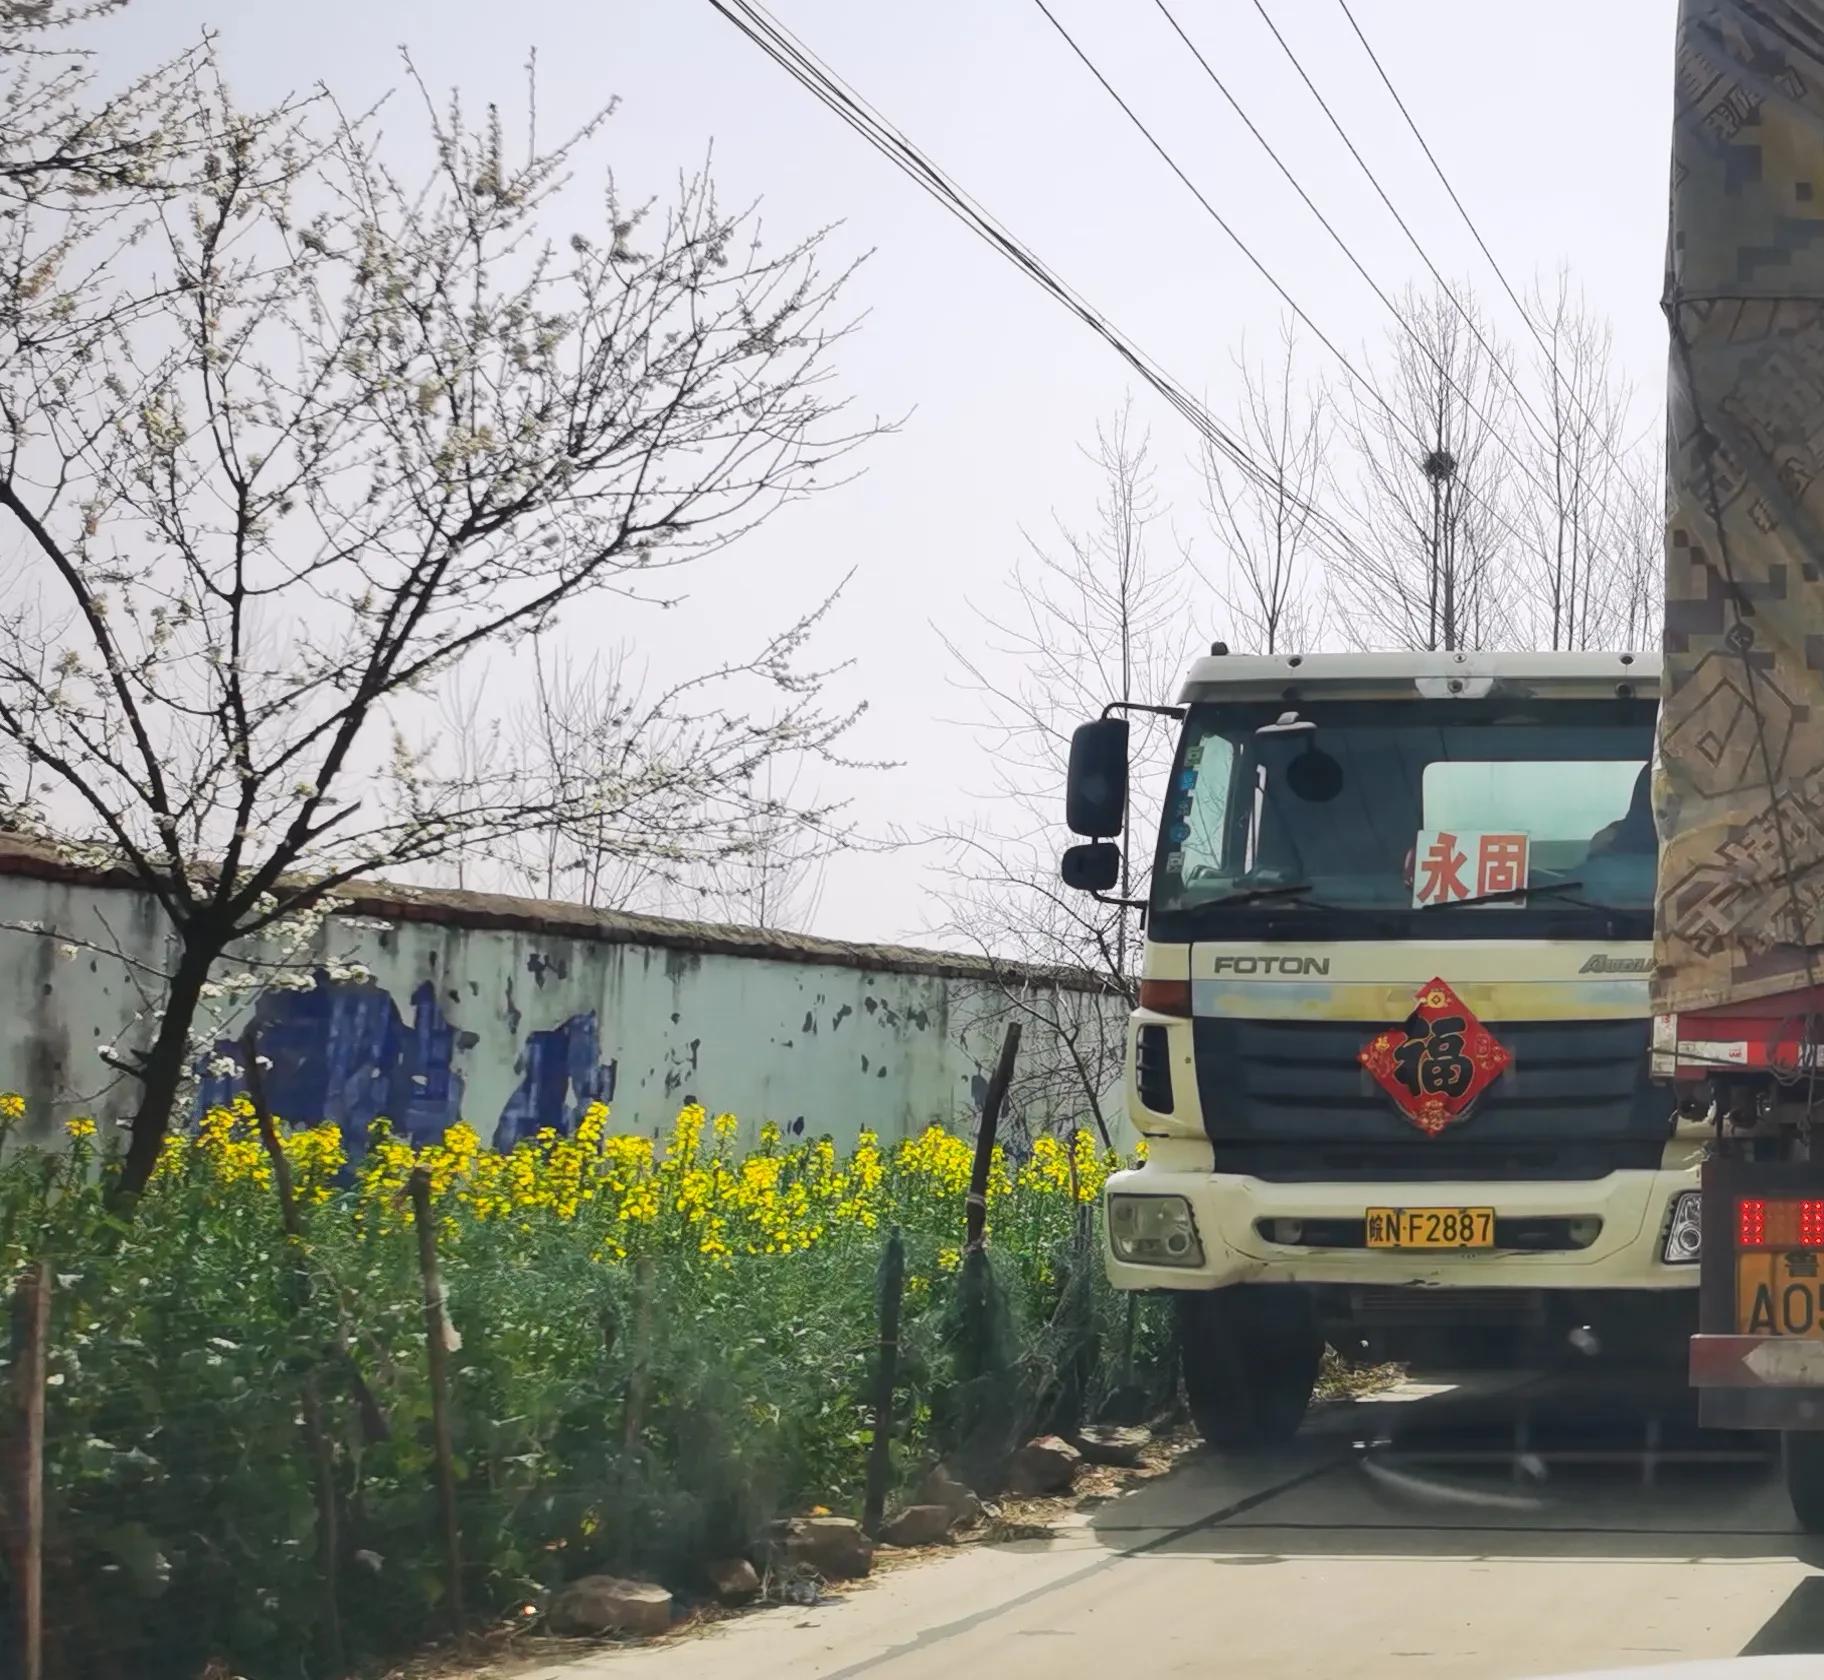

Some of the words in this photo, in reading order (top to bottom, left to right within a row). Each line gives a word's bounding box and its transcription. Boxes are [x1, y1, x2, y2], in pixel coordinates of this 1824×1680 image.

[1416, 832, 1527, 905] 永固
[1214, 956, 1330, 975] FOTON
[1392, 1015, 1475, 1098] 福
